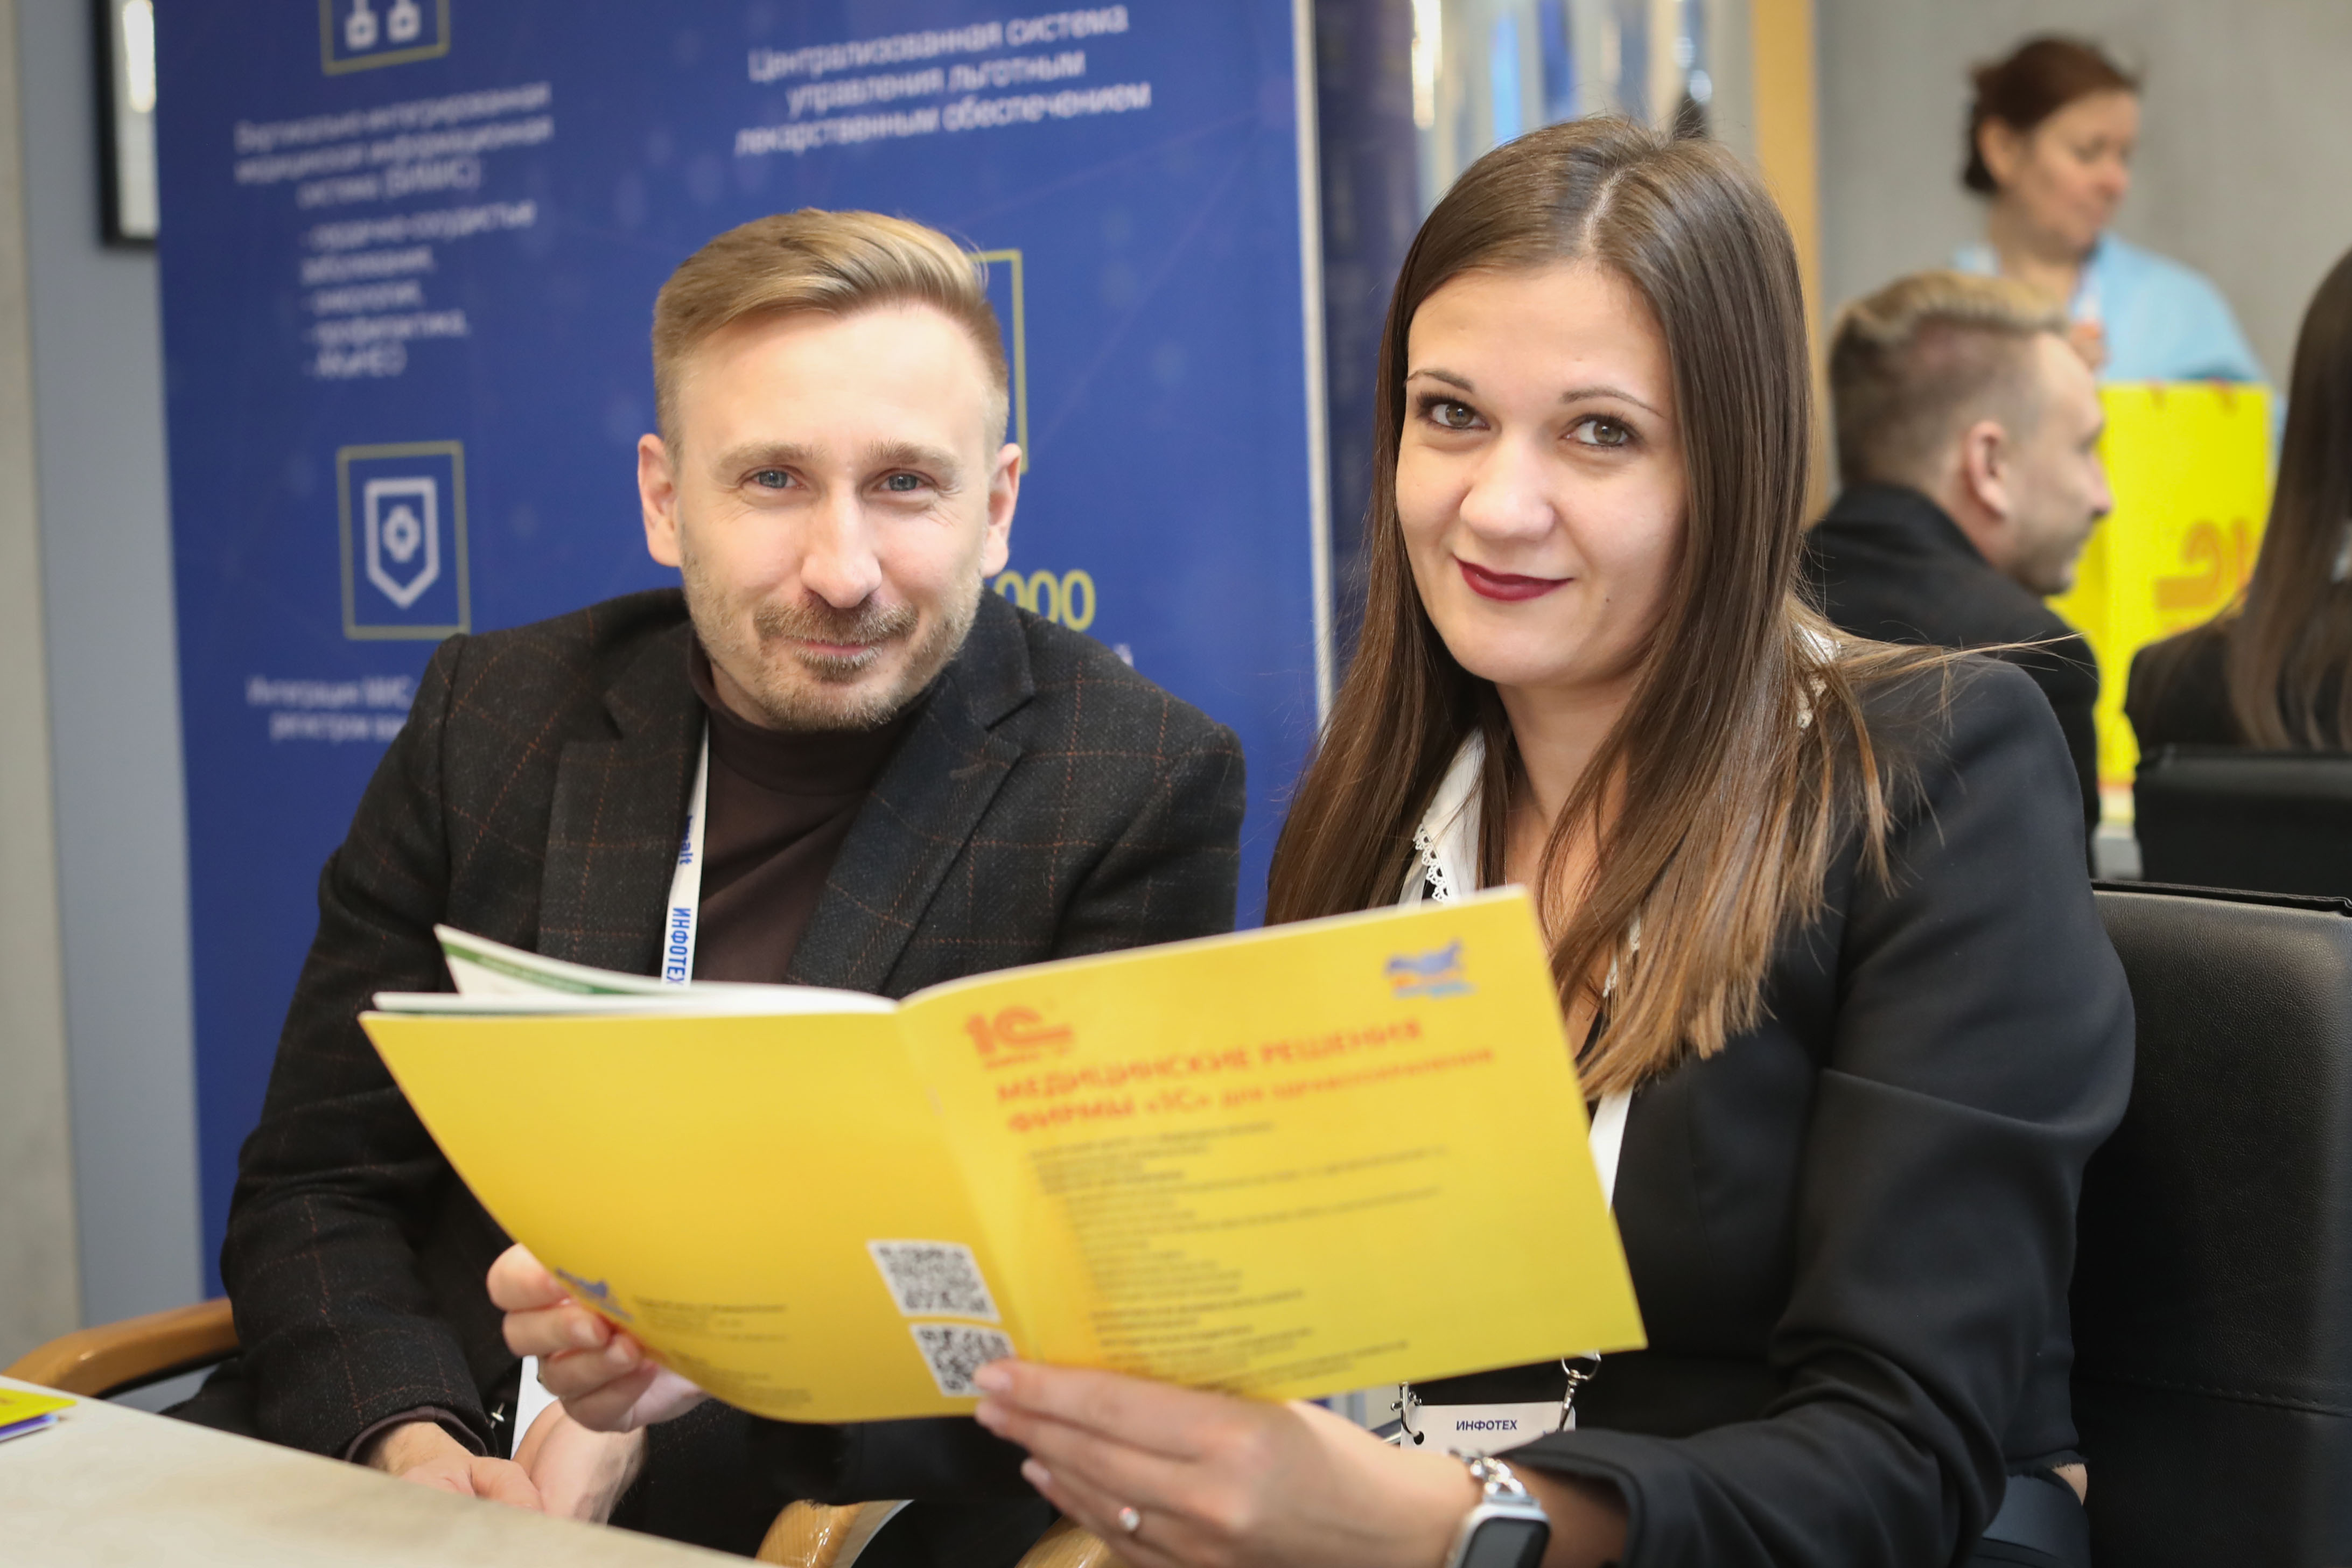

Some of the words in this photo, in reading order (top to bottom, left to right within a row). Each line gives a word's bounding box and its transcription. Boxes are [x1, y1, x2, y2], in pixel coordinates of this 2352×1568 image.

[748, 22, 1003, 81] Централизованная
[1006, 5, 1129, 45] система
[735, 108, 941, 155] лекарственным
[942, 82, 1151, 132] обеспечением
[786, 68, 944, 118] управления
[948, 51, 1086, 91] льготным
[666, 907, 691, 986] ИНФОТЕХ
[996, 1046, 1254, 1103] МЕДИЦИНСКИЕ
[1261, 1016, 1422, 1069] РЕШЕНИЯ
[1006, 1095, 1136, 1136] ФИРМЫ
[1456, 1419, 1518, 1431] ИНФОТЕХ
